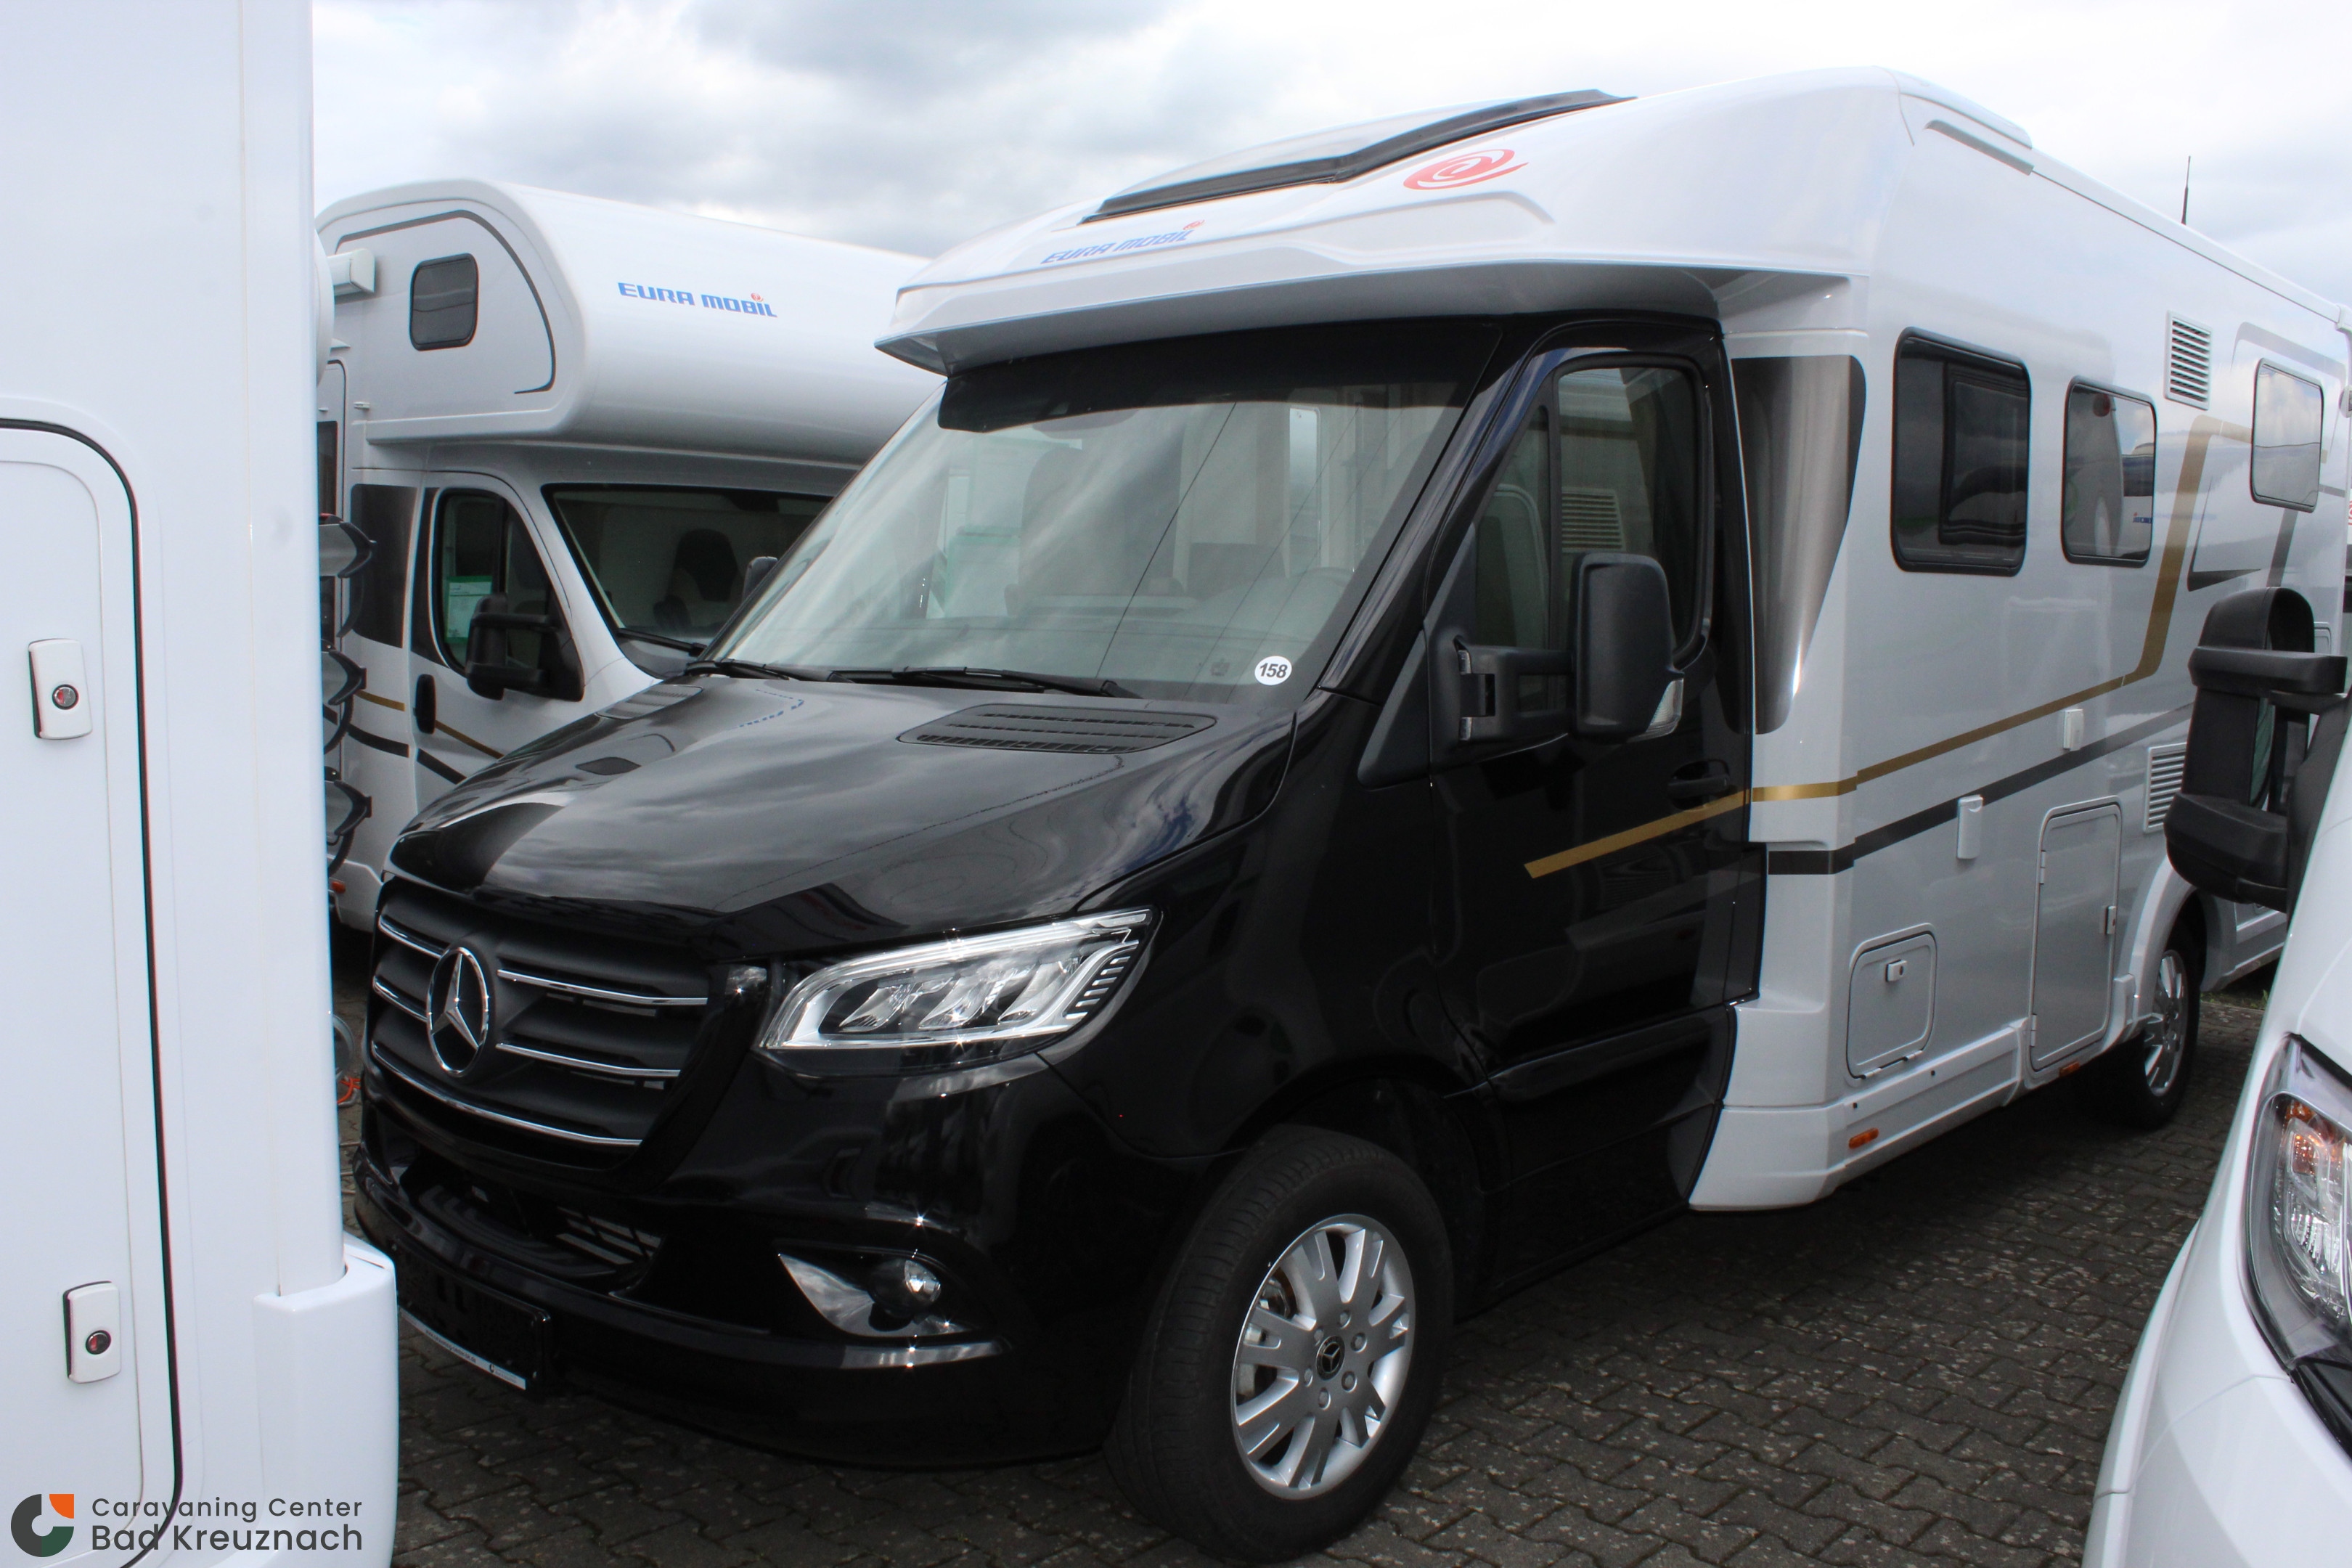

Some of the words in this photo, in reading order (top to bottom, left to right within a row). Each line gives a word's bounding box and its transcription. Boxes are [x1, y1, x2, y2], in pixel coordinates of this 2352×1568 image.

[1040, 242, 1116, 264] EURA
[1113, 229, 1195, 252] MOBIL
[618, 282, 695, 306] EURA
[701, 293, 778, 318] MOBIL
[1259, 662, 1288, 679] 158
